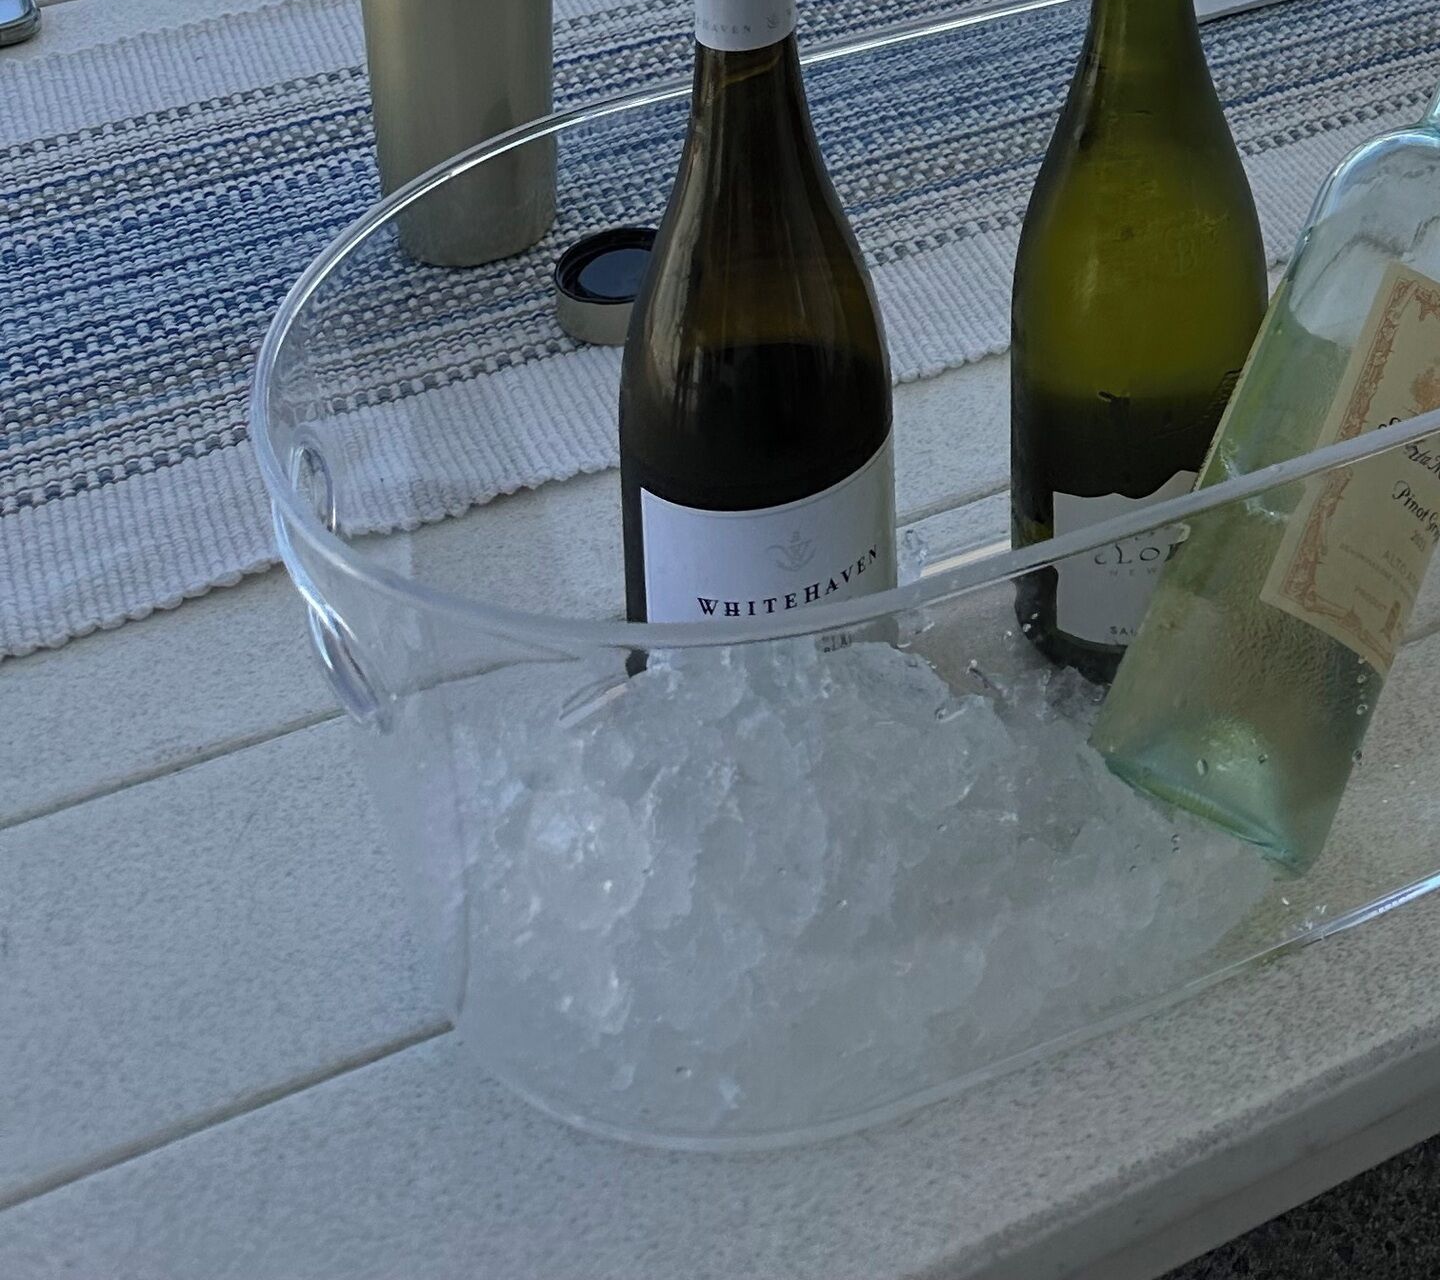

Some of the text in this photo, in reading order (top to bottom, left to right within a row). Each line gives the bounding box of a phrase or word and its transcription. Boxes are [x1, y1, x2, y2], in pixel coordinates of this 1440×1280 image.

[1391, 480, 1430, 522] Pinot
[1094, 542, 1173, 566] CLO
[697, 543, 880, 619] WHITEHAVEN
